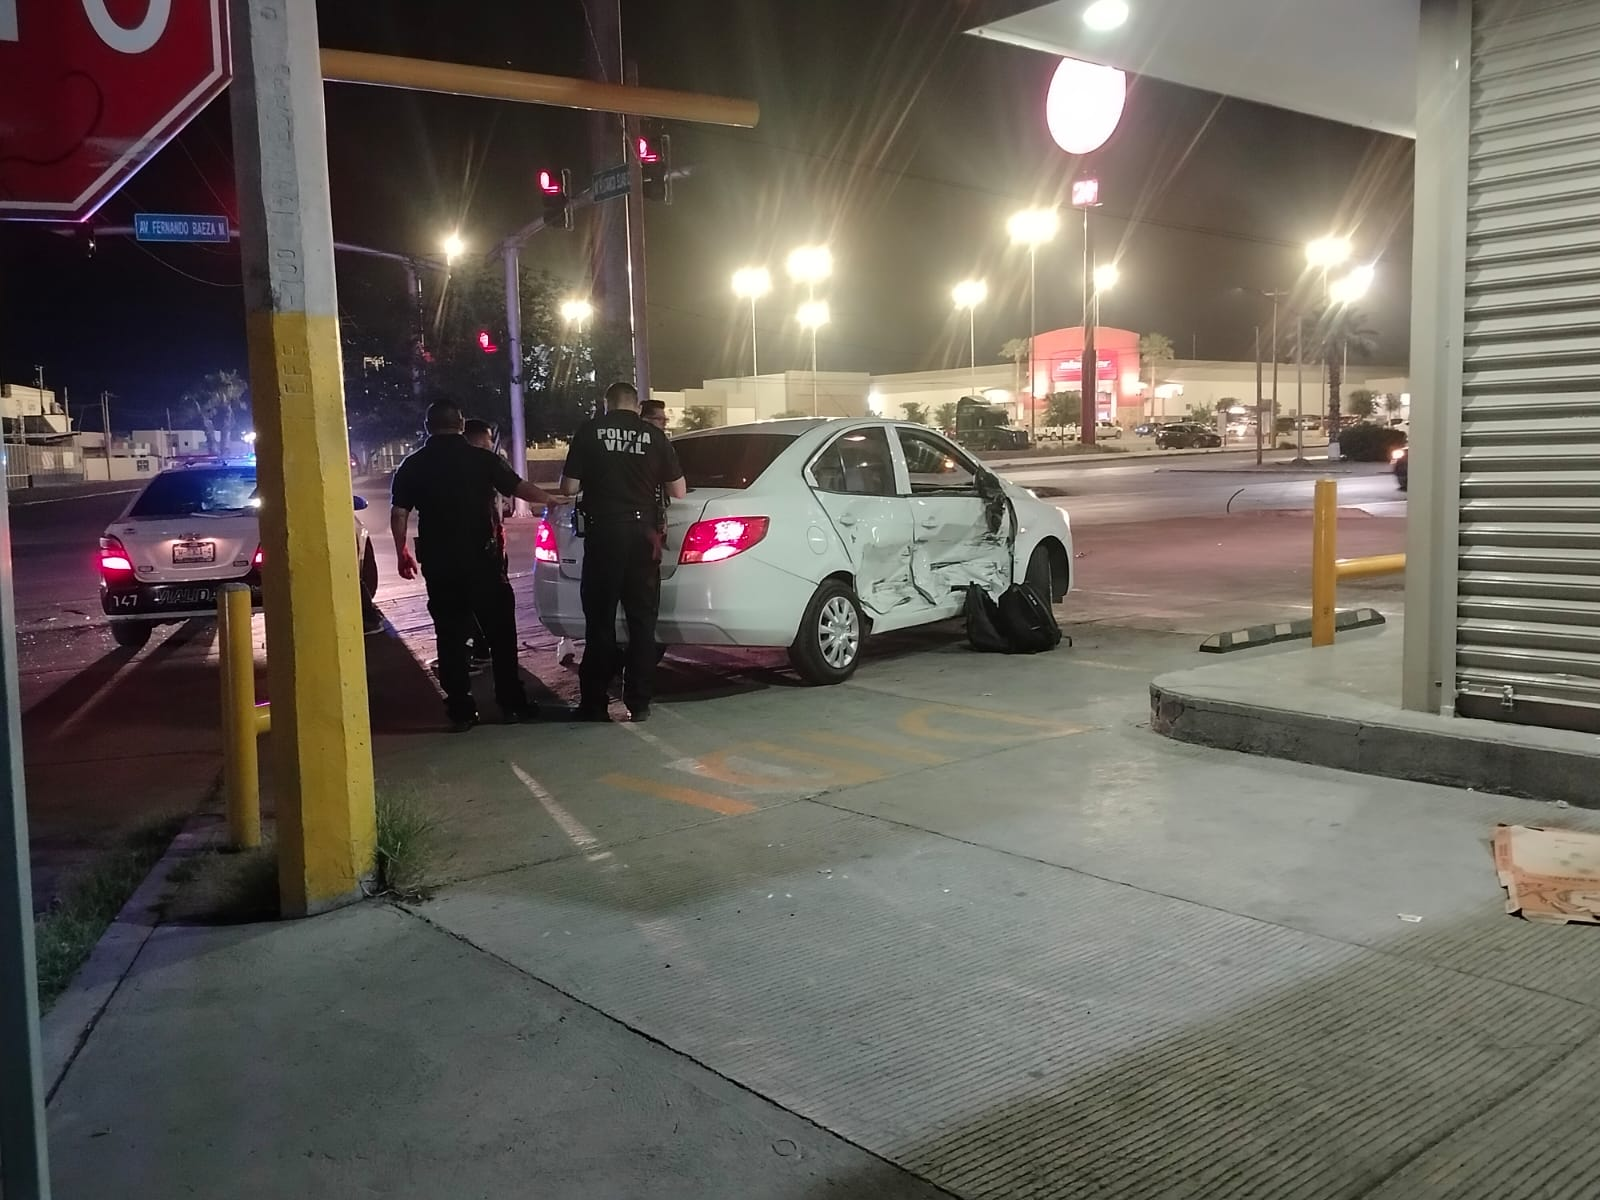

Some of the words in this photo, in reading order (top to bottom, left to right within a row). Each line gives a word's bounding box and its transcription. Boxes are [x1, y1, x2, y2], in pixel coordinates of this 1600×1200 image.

[152, 220, 189, 235] FERNANDO
[192, 222, 216, 236] BAEZA
[597, 428, 651, 443] POLICIA
[604, 439, 645, 455] VIAL
[113, 594, 138, 607] 147
[157, 588, 218, 605] VIALIDA
